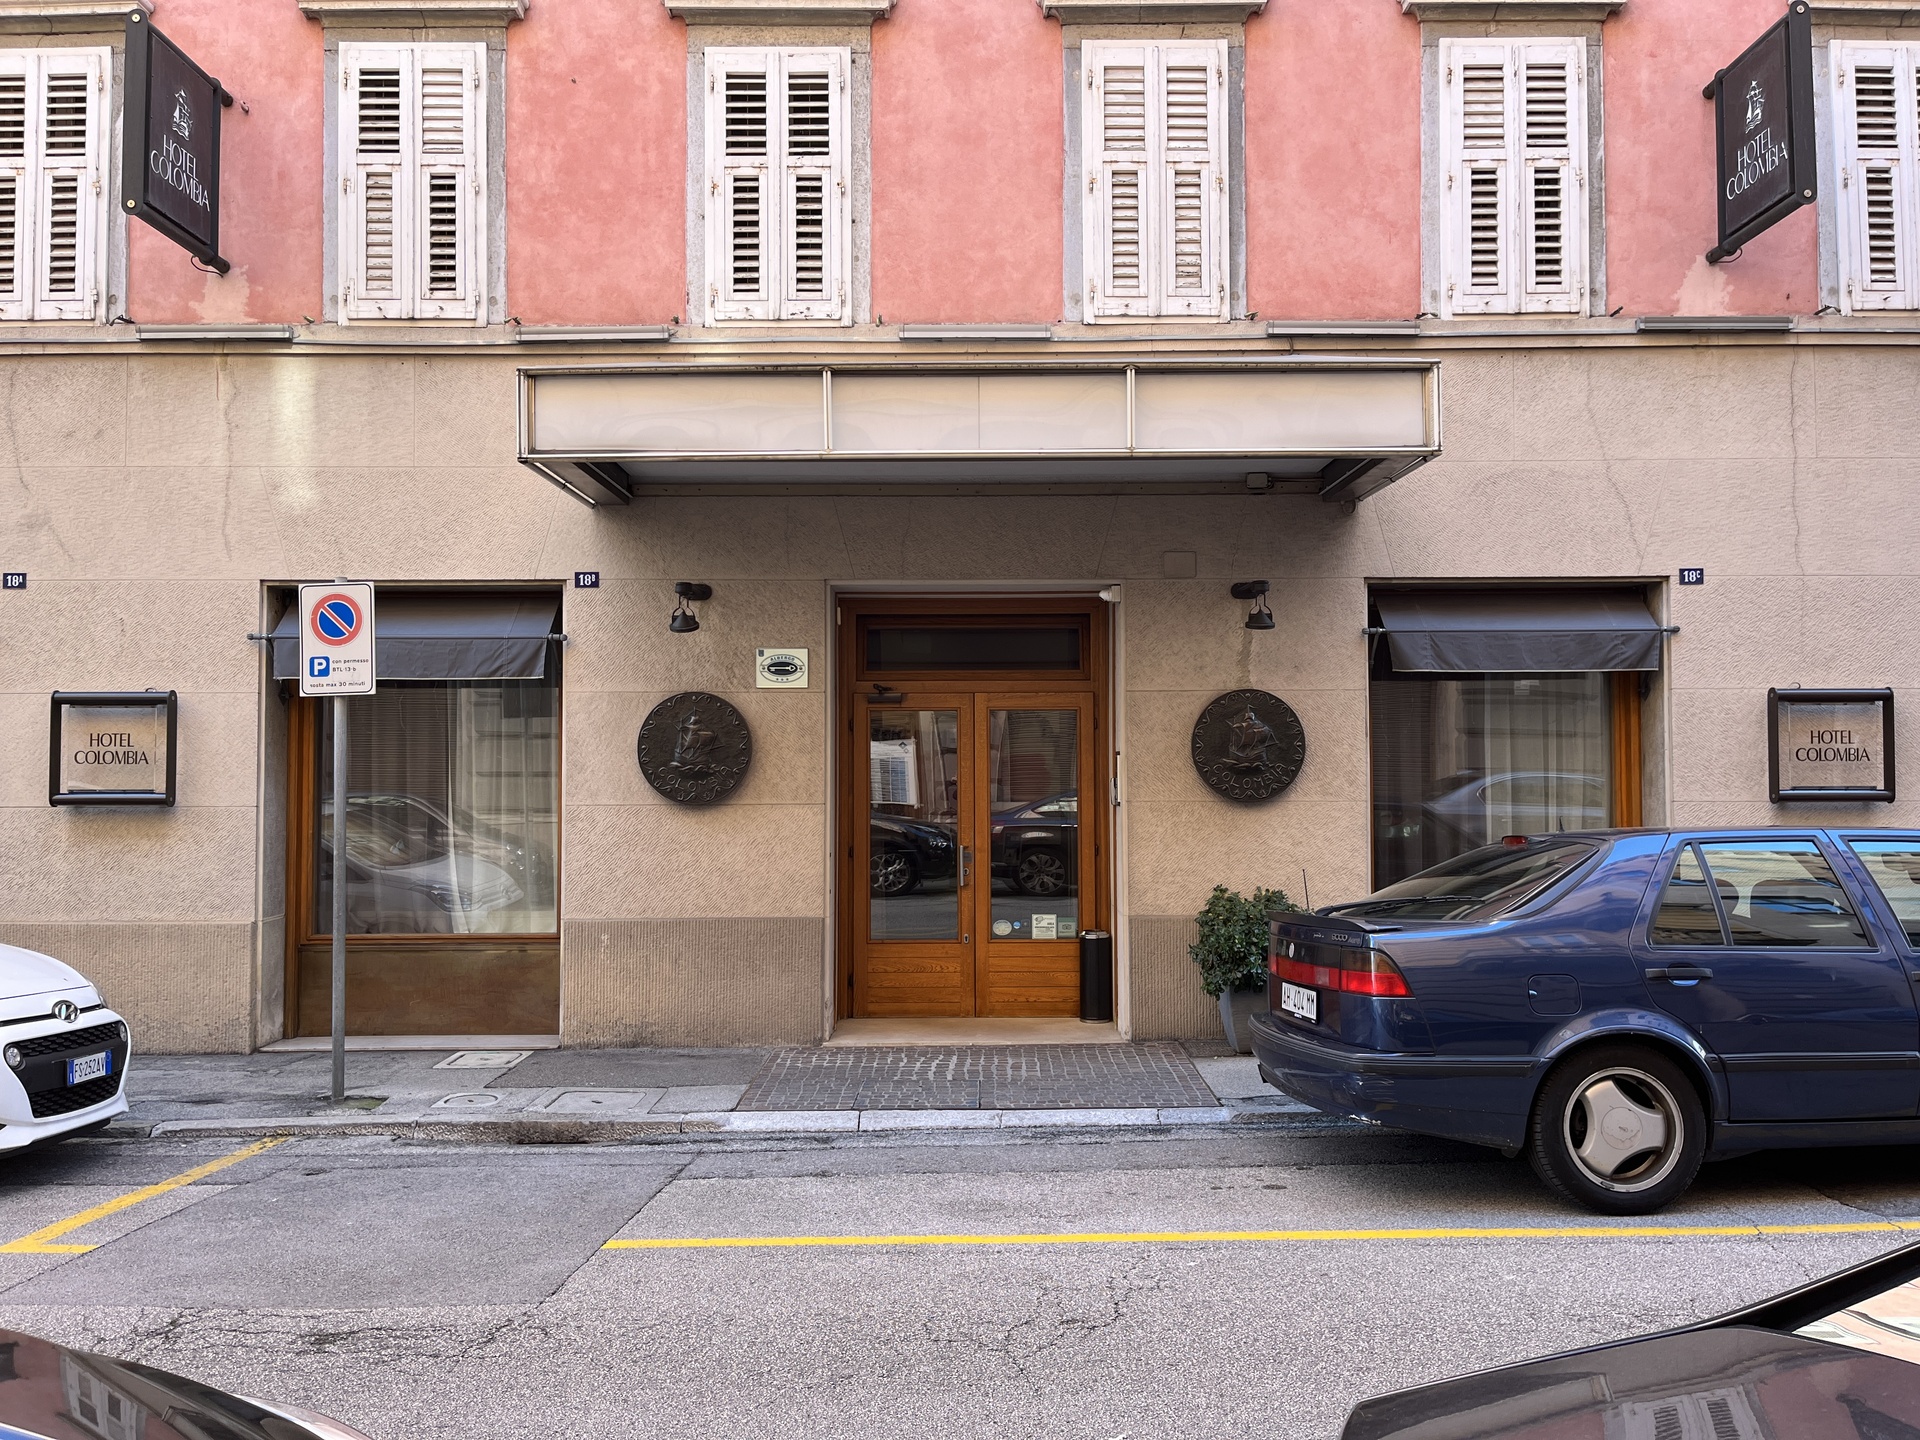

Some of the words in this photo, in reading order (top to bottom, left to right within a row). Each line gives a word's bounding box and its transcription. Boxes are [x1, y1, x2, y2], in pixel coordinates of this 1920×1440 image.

[163, 134, 199, 182] HOTEL
[1737, 127, 1772, 172] HOTEL
[150, 149, 210, 212] COLOMBIA
[1726, 141, 1788, 200] COLOMBIA
[313, 658, 327, 676] P
[89, 732, 135, 748] HOTEL
[1810, 729, 1856, 745] HOTEL
[74, 750, 149, 765] COLOMBIA
[1795, 747, 1871, 762] COLOMBIA
[658, 765, 732, 792] COLOMBIA
[1212, 763, 1287, 789] COLOMBIA
